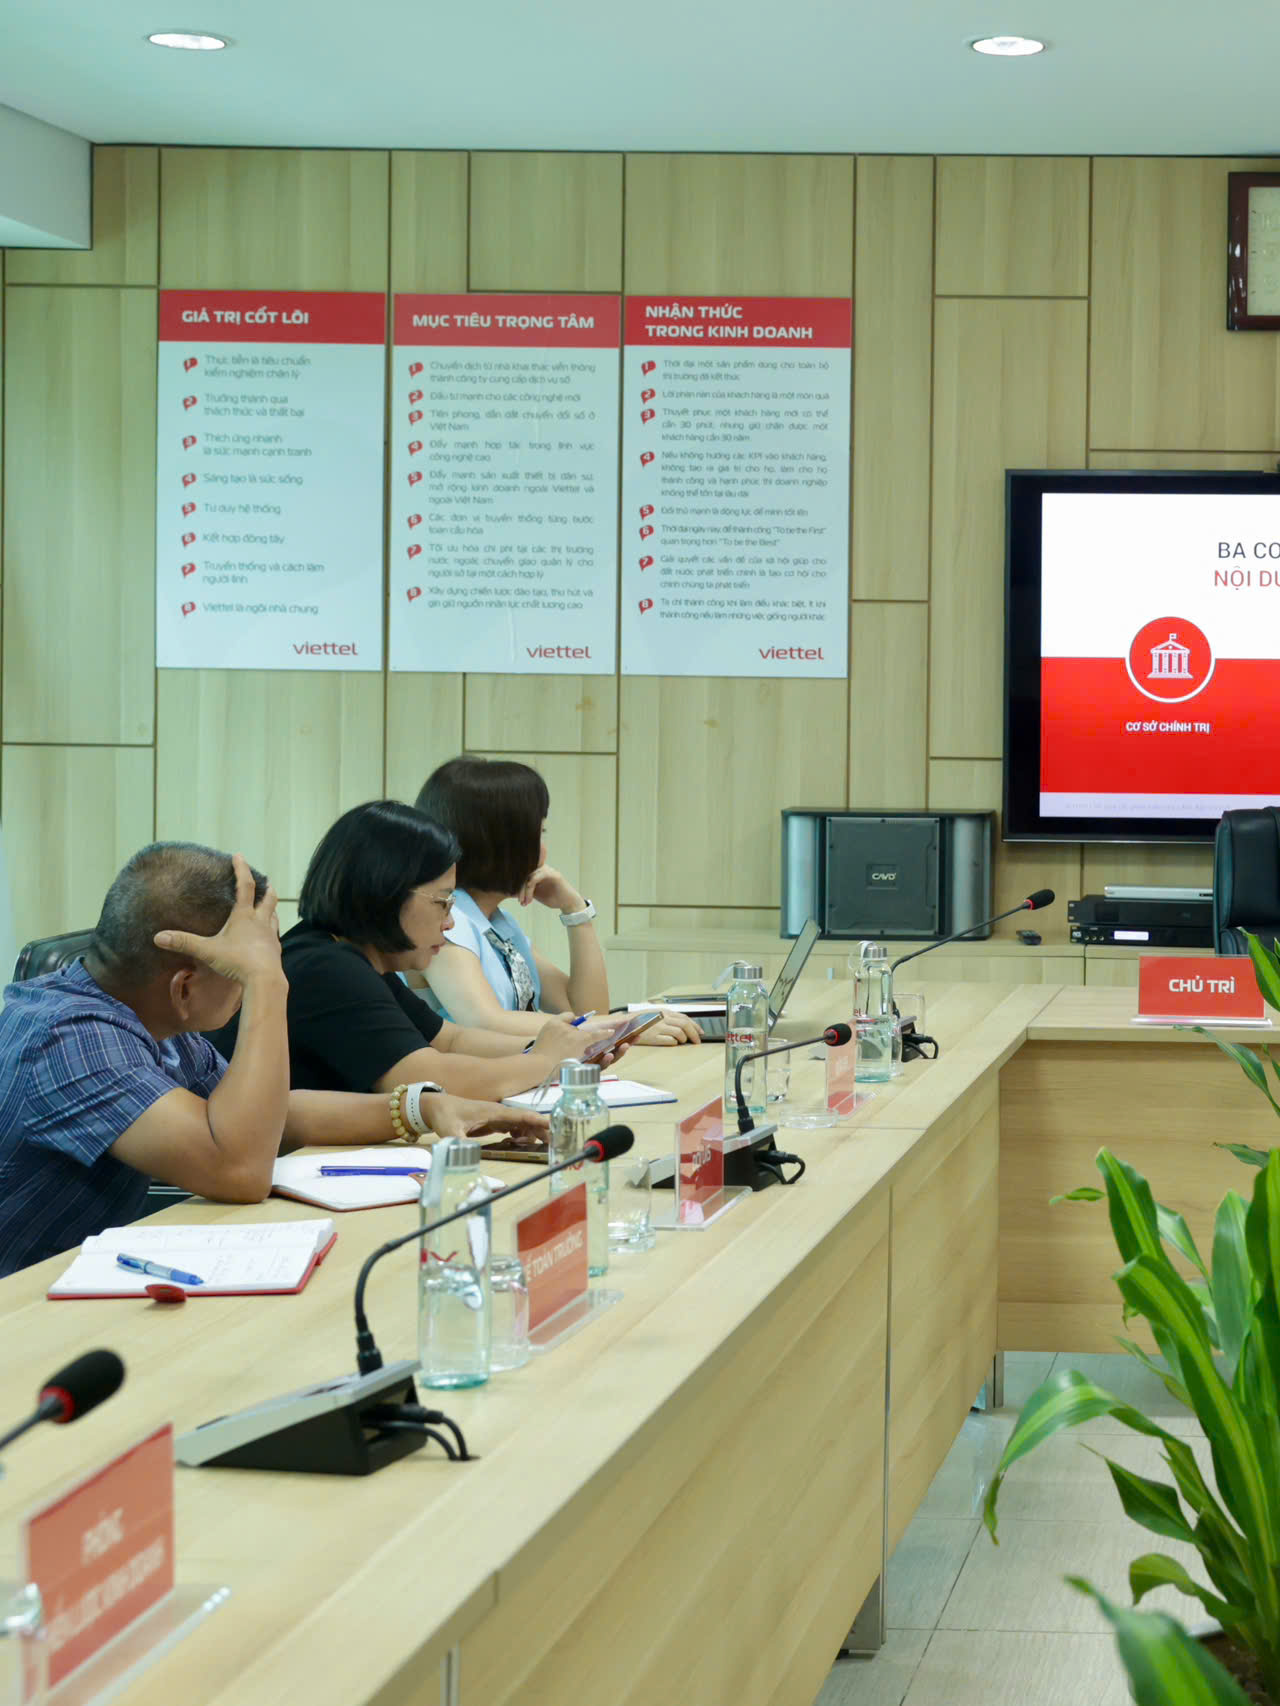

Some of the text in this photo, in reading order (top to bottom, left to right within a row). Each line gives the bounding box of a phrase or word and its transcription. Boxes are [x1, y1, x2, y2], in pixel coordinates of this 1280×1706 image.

[182, 306, 309, 324] GIÁ TRỊ CỐT LÕI
[646, 303, 742, 320] NHẬN THỨC
[413, 312, 594, 329] MỤC TIÊU TRỌNG TÂM
[645, 326, 812, 338] TRONG KINH DOANH
[1218, 542, 1246, 558] BA
[1214, 570, 1250, 590] NỘI
[293, 642, 358, 655] viettel
[526, 645, 590, 658] viettel
[758, 646, 823, 659] viettel
[1126, 720, 1210, 734] CƠ SỞ CHÍNH TRỊ
[1169, 976, 1234, 993] CHỦ TRÌ
